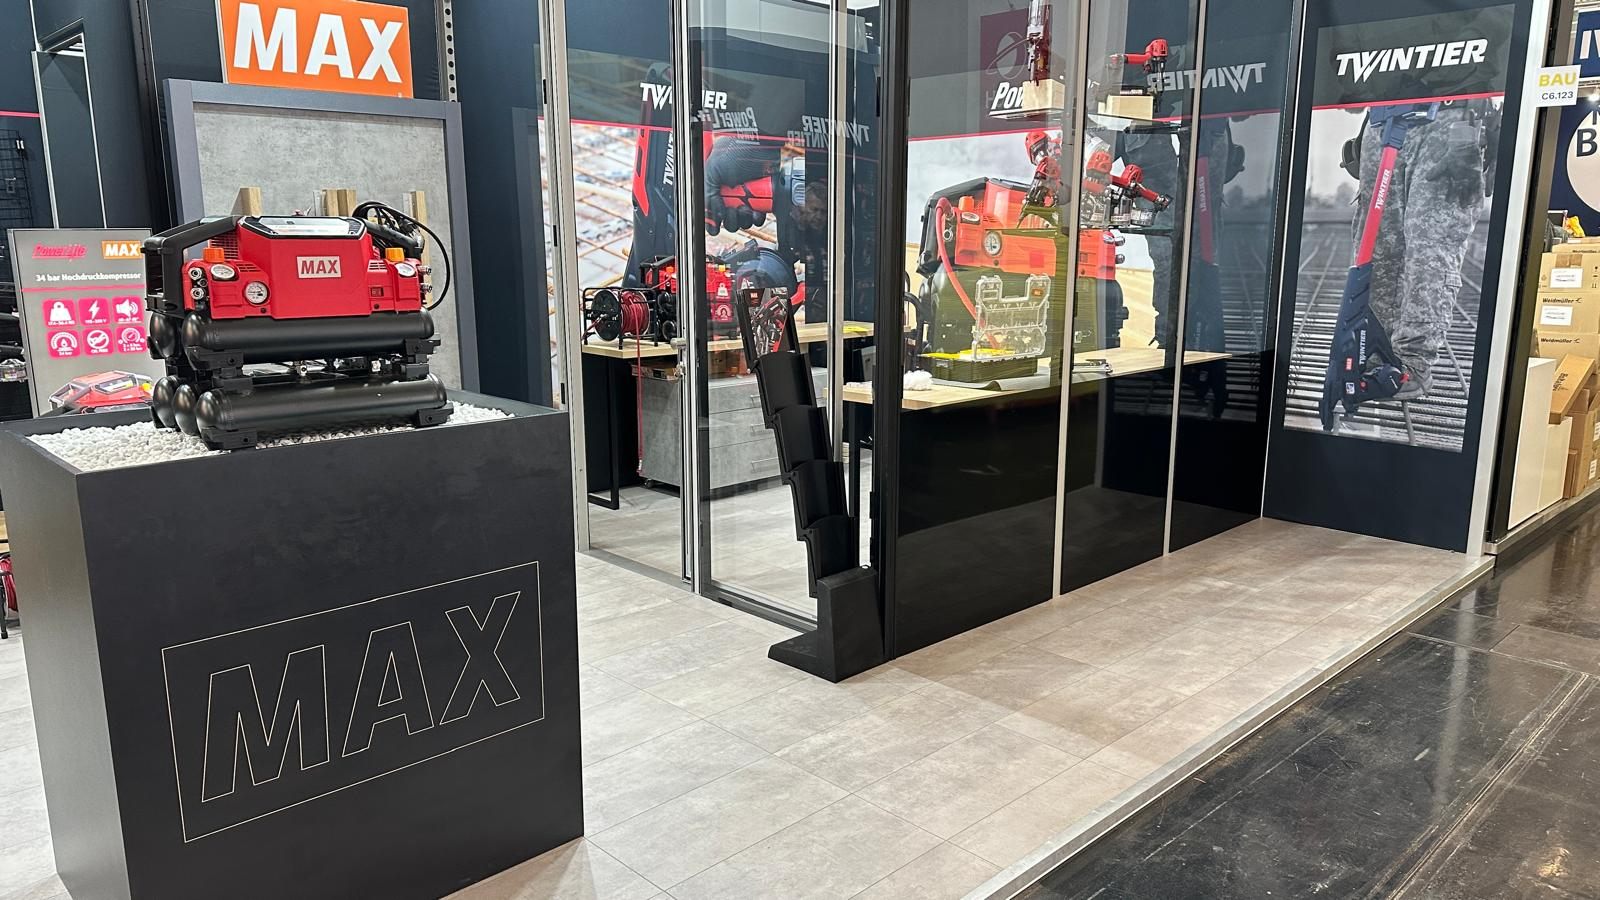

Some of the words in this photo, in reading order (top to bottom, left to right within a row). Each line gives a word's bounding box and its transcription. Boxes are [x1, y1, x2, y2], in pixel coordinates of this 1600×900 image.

[233, 2, 403, 83] MAX
[1336, 38, 1488, 83] TWINTIER
[1539, 72, 1577, 87] BAU
[1541, 91, 1574, 101] C6.123
[1375, 168, 1391, 210] TWINTIER
[105, 243, 140, 256] MAX
[300, 259, 338, 275] MAX
[47, 273, 60, 281] bar
[201, 591, 521, 804] MAX
